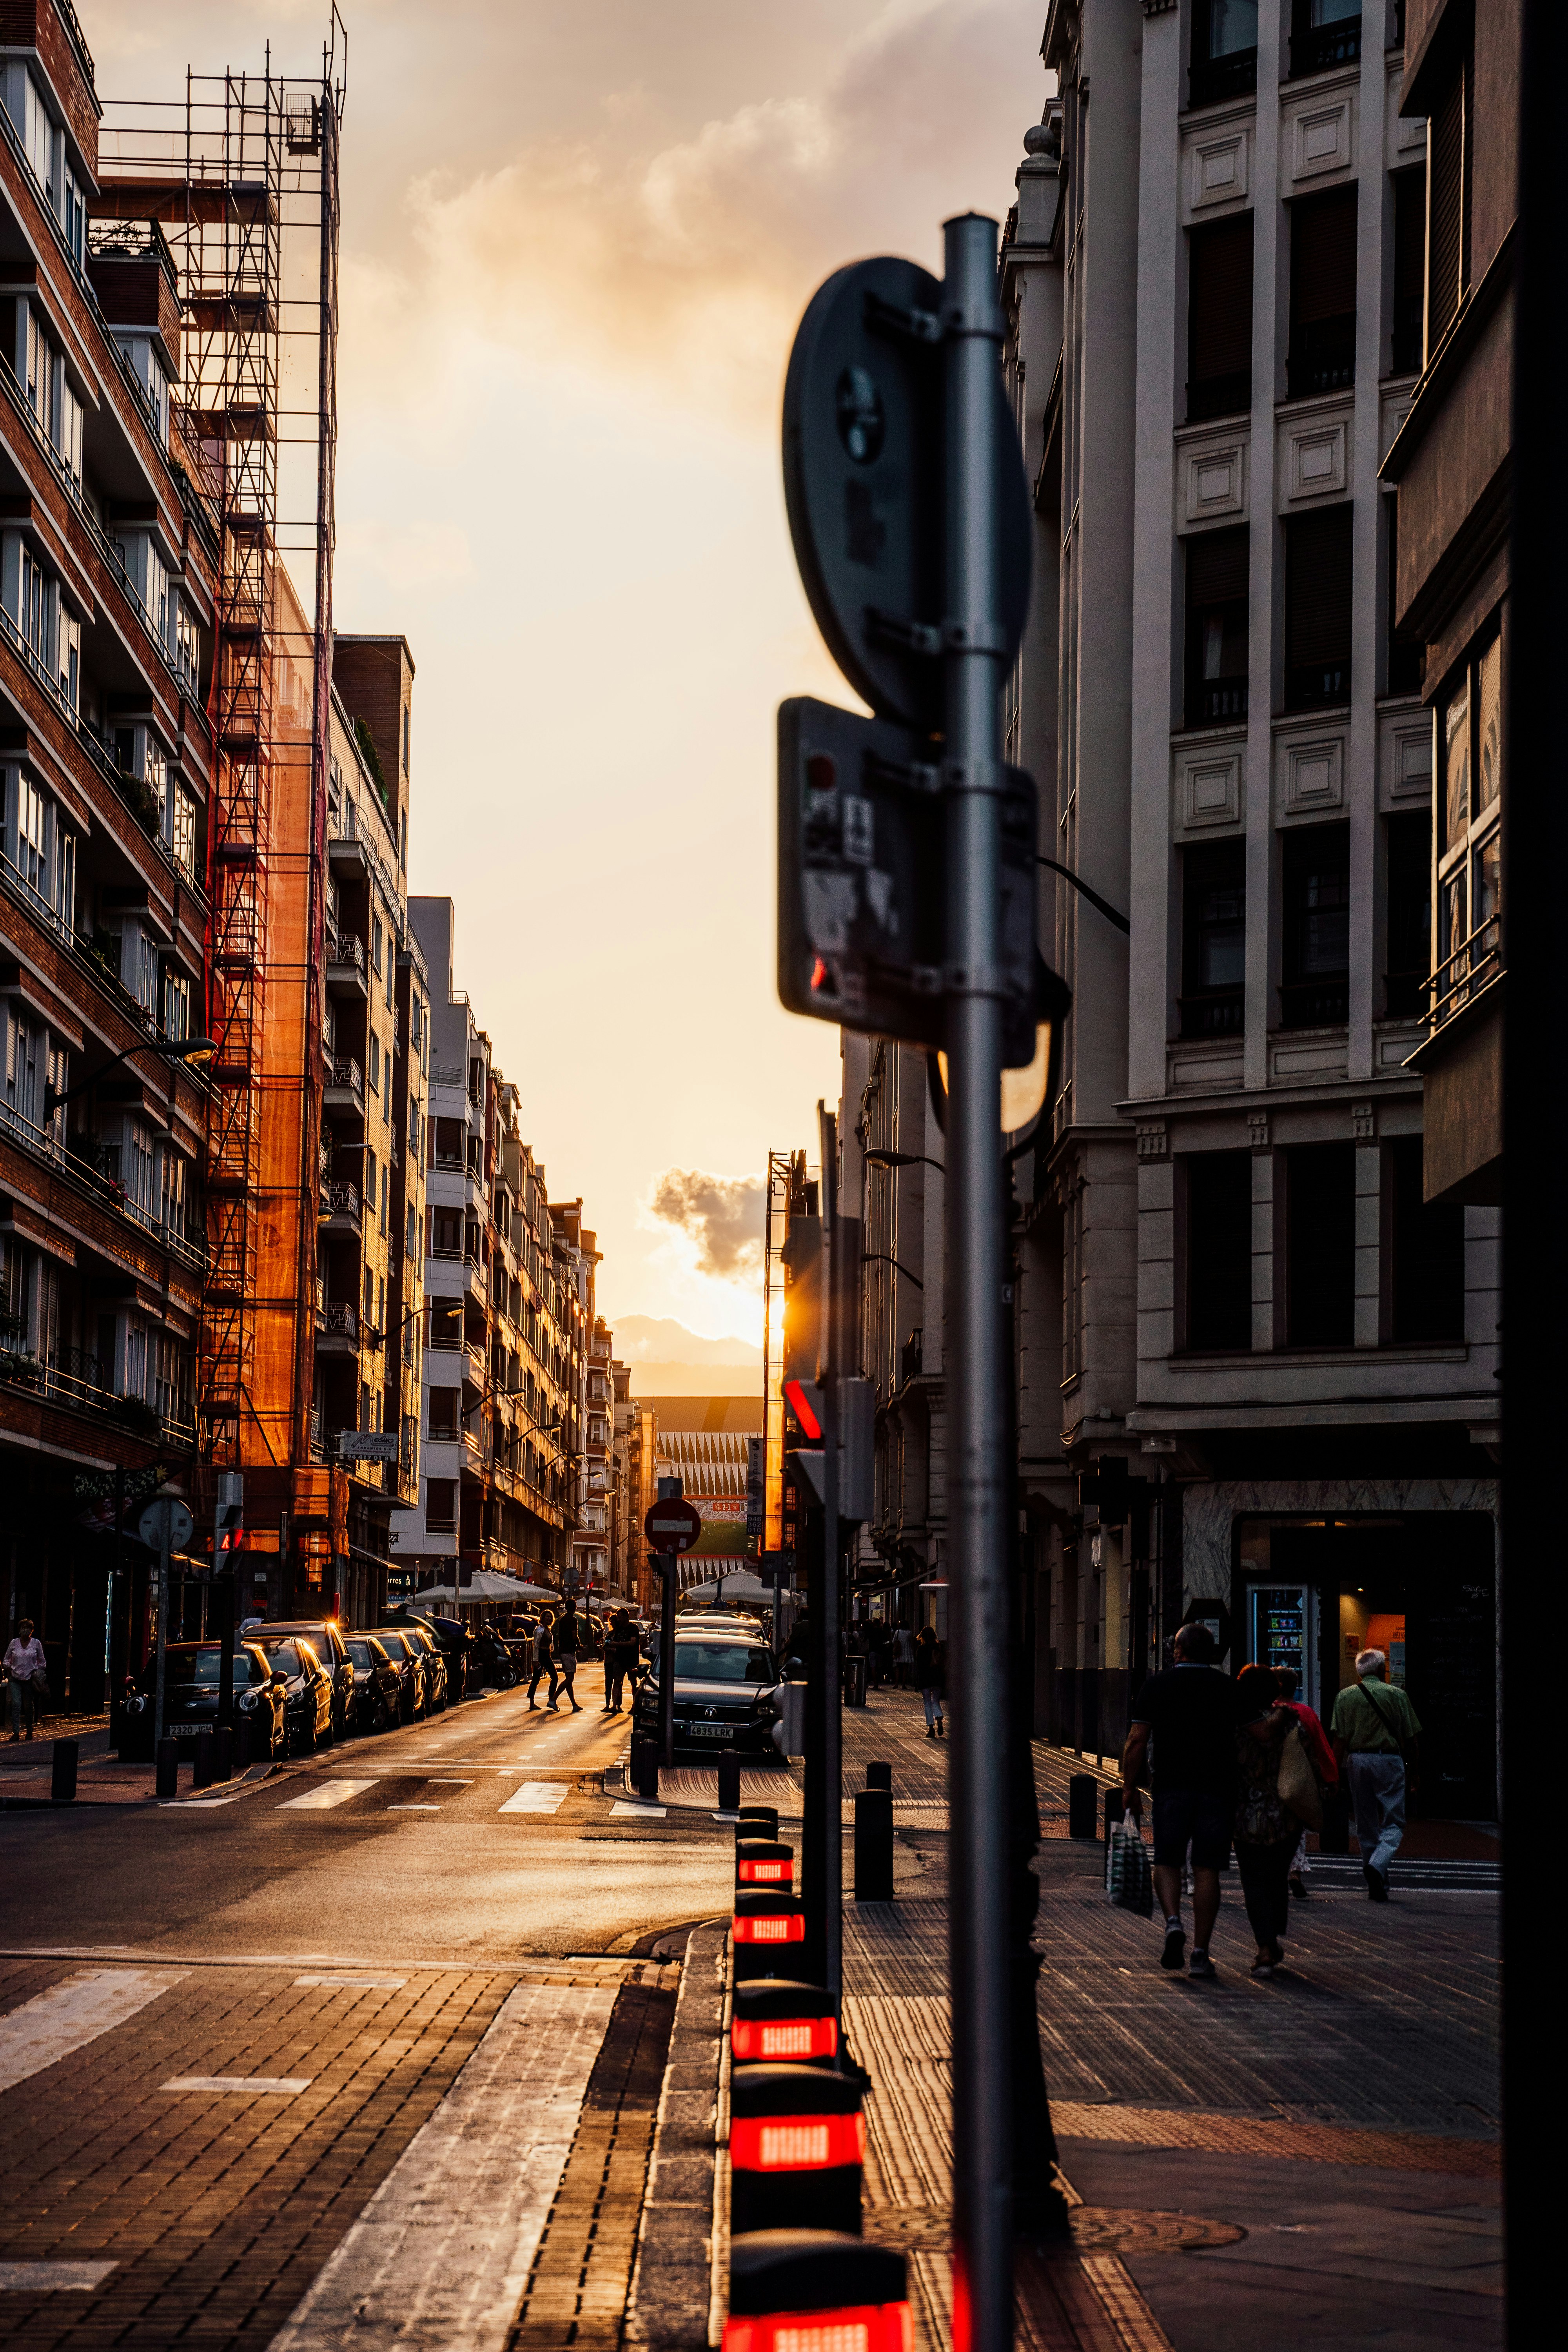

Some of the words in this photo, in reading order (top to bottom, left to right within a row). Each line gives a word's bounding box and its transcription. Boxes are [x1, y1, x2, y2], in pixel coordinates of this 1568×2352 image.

[171, 1726, 192, 1735] 2320
[691, 1727, 712, 1736] 4835
[715, 1728, 731, 1737] LRK
